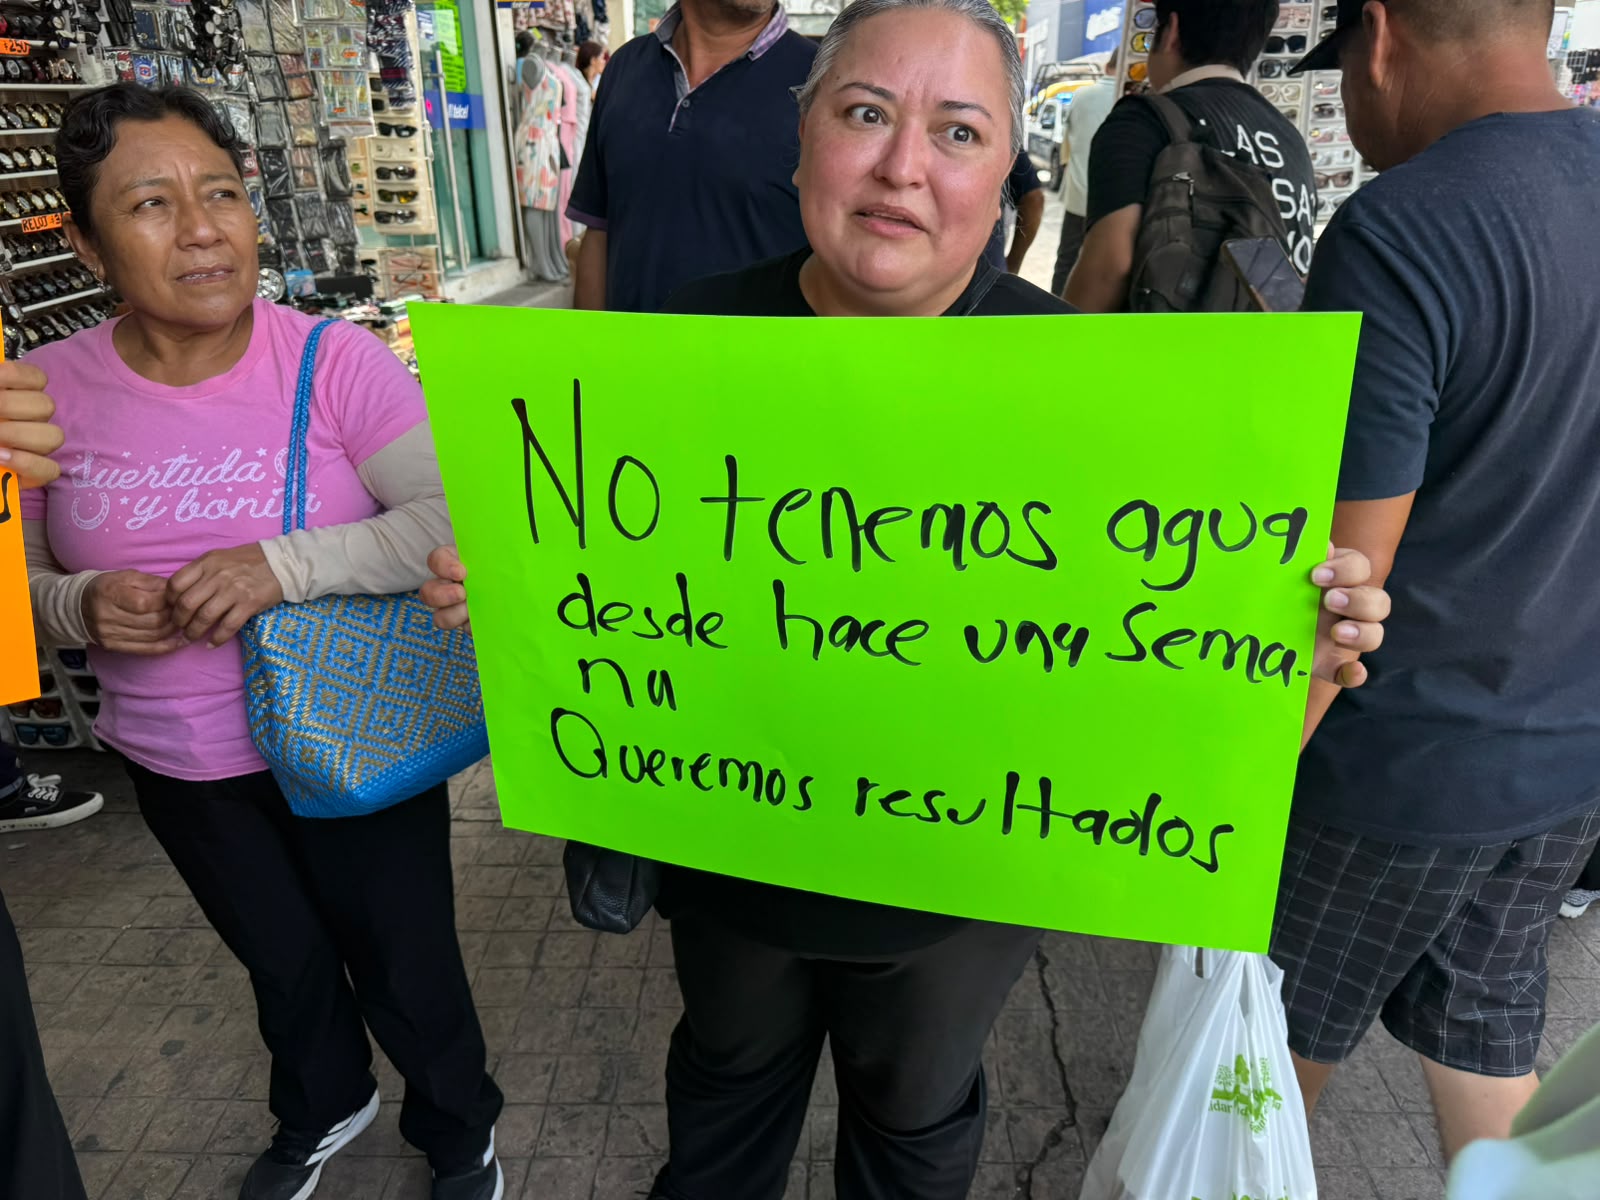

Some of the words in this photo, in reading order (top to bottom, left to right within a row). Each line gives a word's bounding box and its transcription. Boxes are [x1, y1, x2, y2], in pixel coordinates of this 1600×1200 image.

[22, 215, 48, 232] RELOJ
[125, 495, 167, 531] y
[511, 378, 660, 549] No
[700, 454, 1058, 572] tenemos
[1106, 499, 1308, 592] agua
[557, 572, 729, 649] desde
[772, 578, 930, 666] hace
[964, 619, 1090, 673] una
[577, 657, 677, 712] na
[550, 707, 814, 812] Queremos
[855, 770, 1235, 874] resultados
